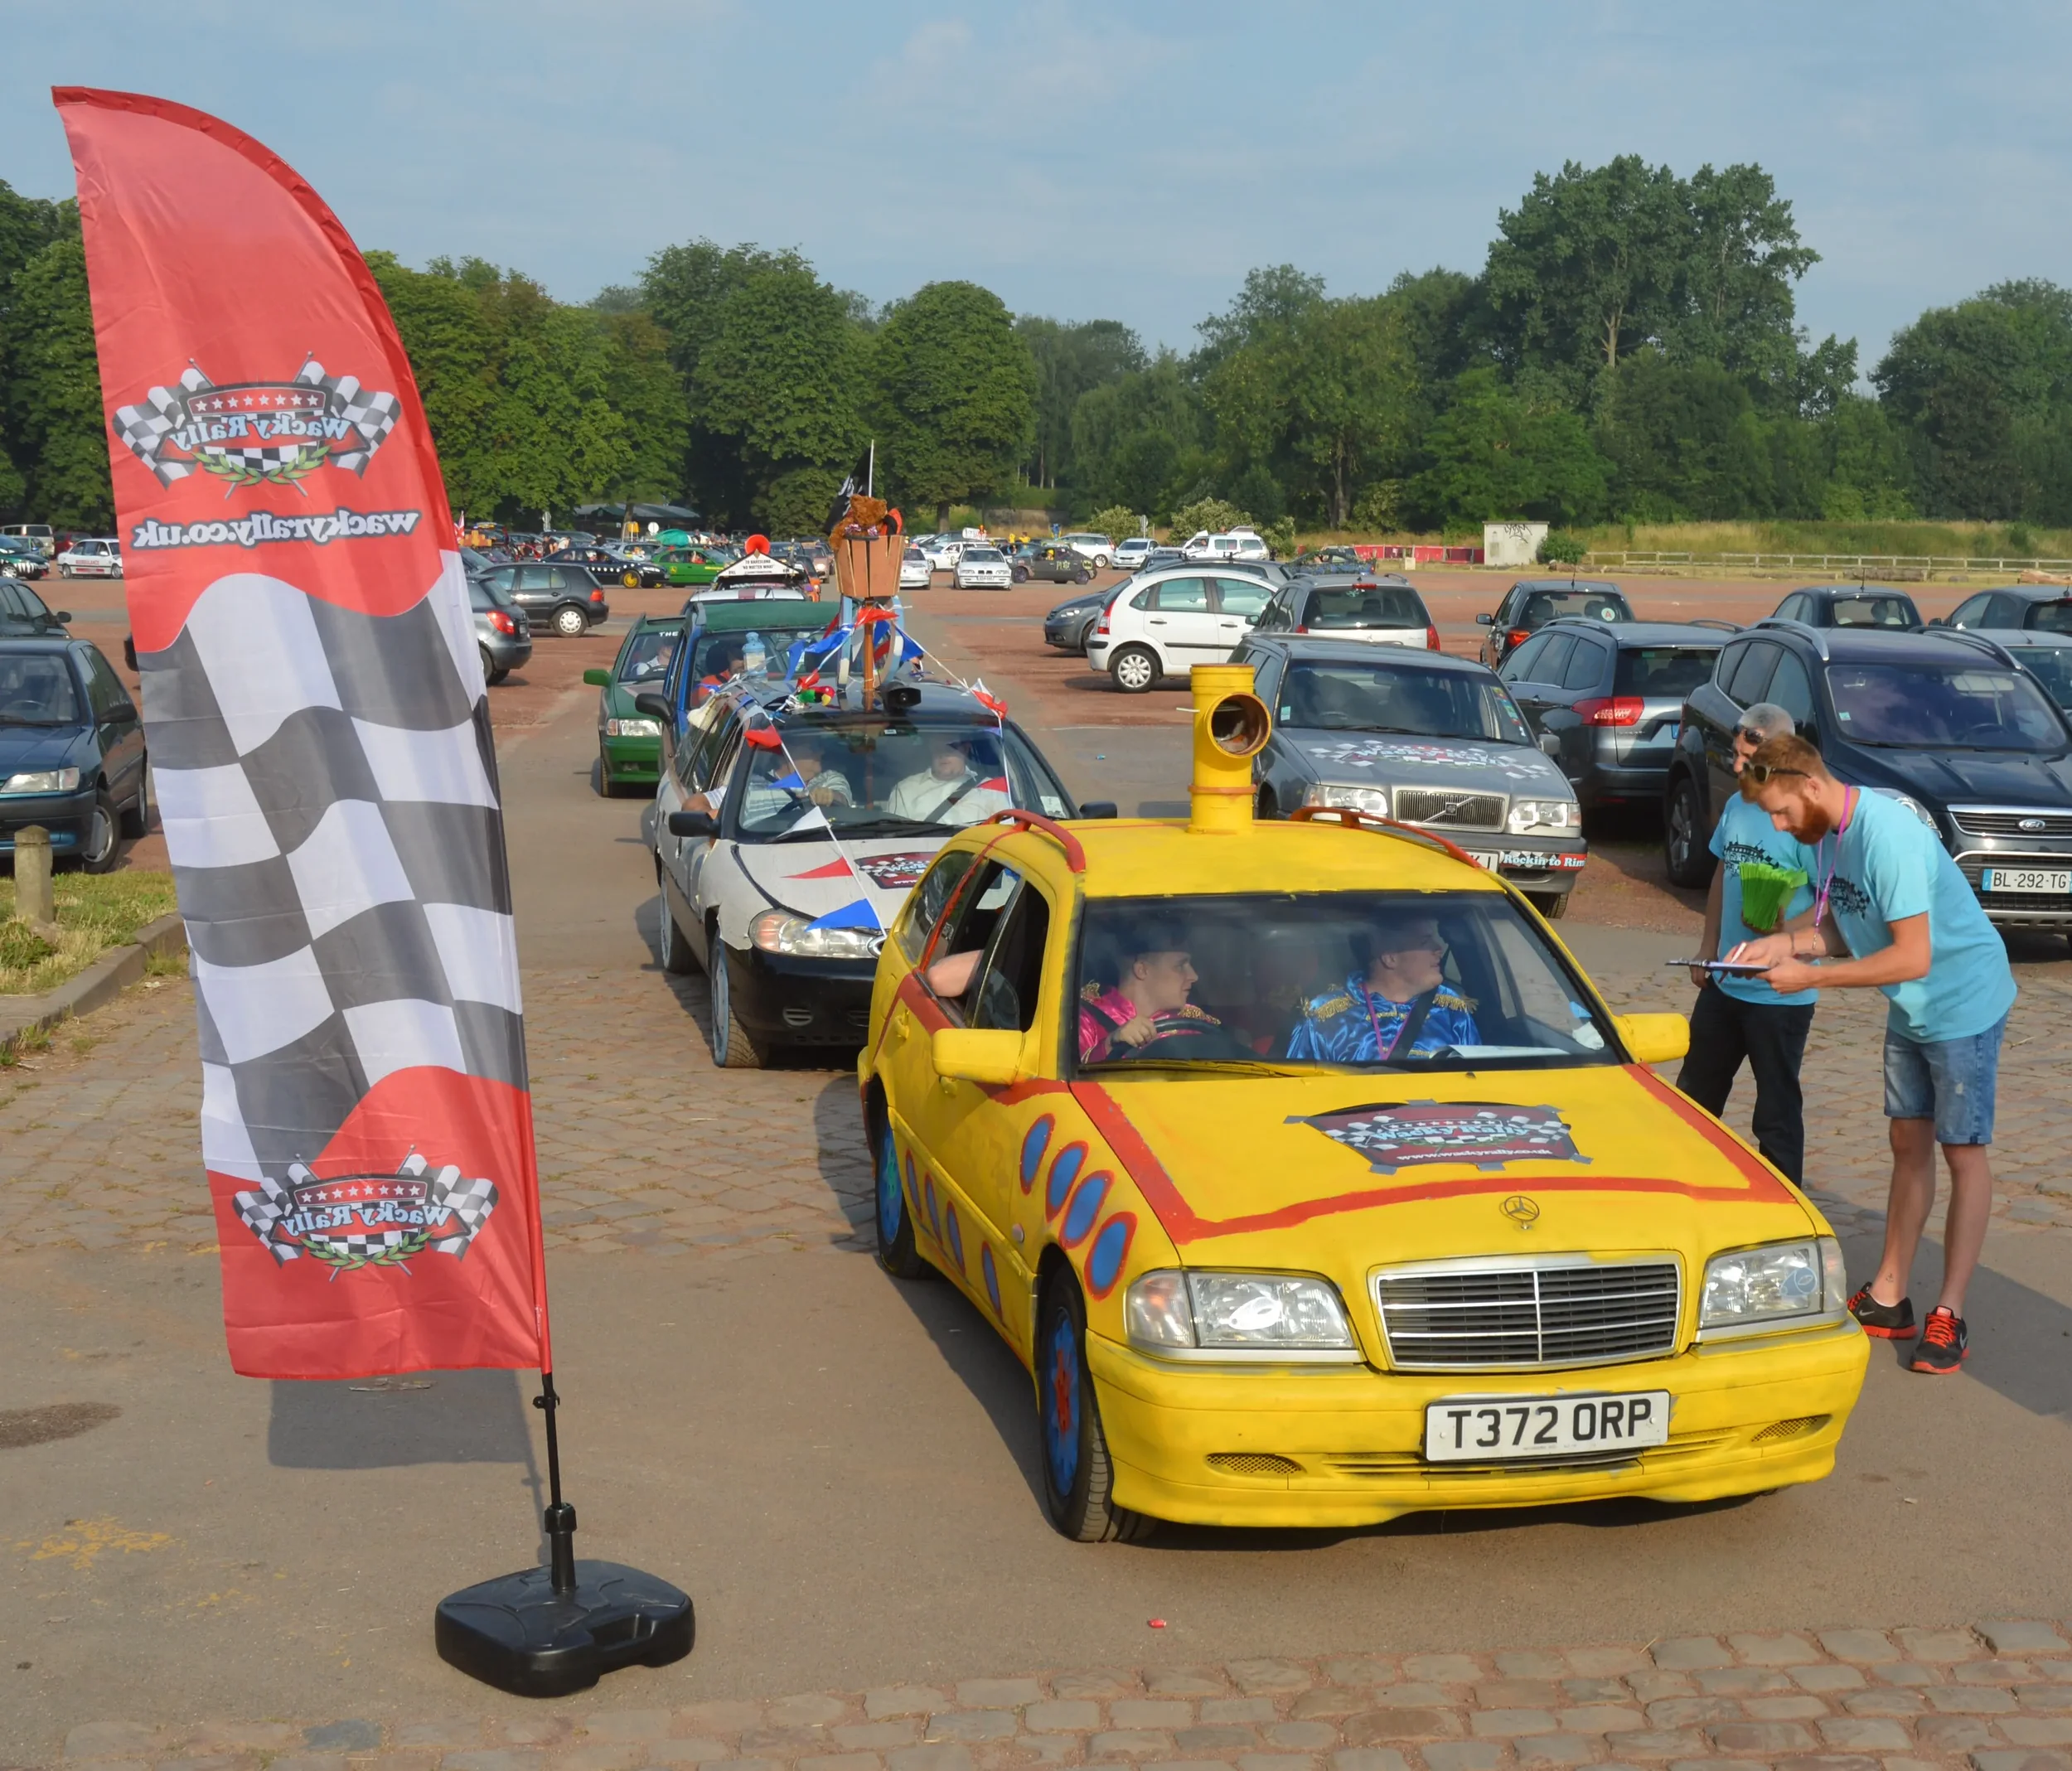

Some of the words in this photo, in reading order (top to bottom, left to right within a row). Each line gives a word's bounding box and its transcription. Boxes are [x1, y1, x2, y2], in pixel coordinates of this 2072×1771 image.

[1503, 854, 1546, 866] Rockin
[1549, 857, 1561, 866] to
[1372, 1125, 1460, 1141] Wacky
[1459, 1125, 1530, 1138] Rally
[1397, 1149, 1552, 1161] www.wackyrally.co.uk
[1447, 1406, 1558, 1449] T372
[1572, 1398, 1652, 1442] ORP
